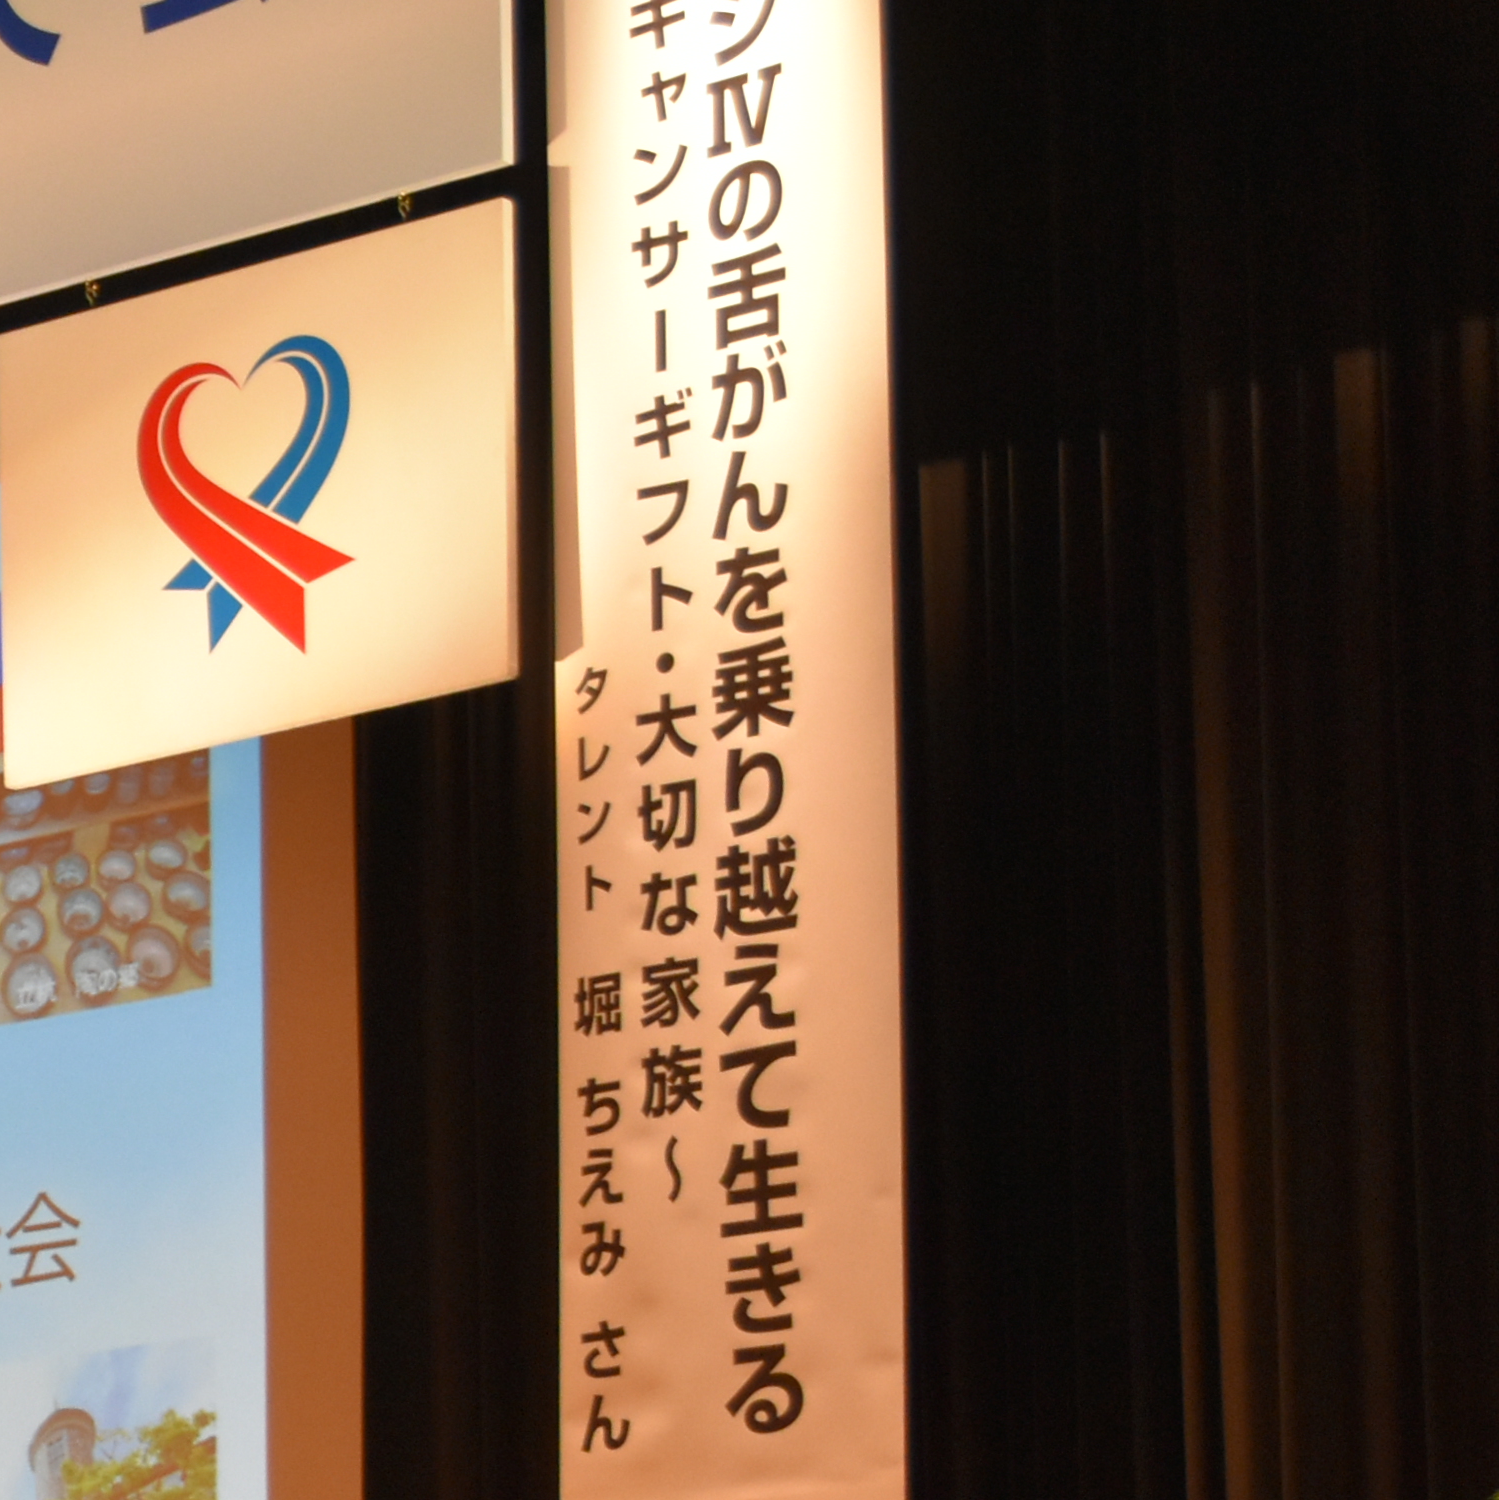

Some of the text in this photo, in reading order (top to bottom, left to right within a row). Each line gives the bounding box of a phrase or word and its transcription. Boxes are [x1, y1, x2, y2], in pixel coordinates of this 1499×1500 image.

[574, 666, 630, 1454] タレント 堀 ちえみ さん
